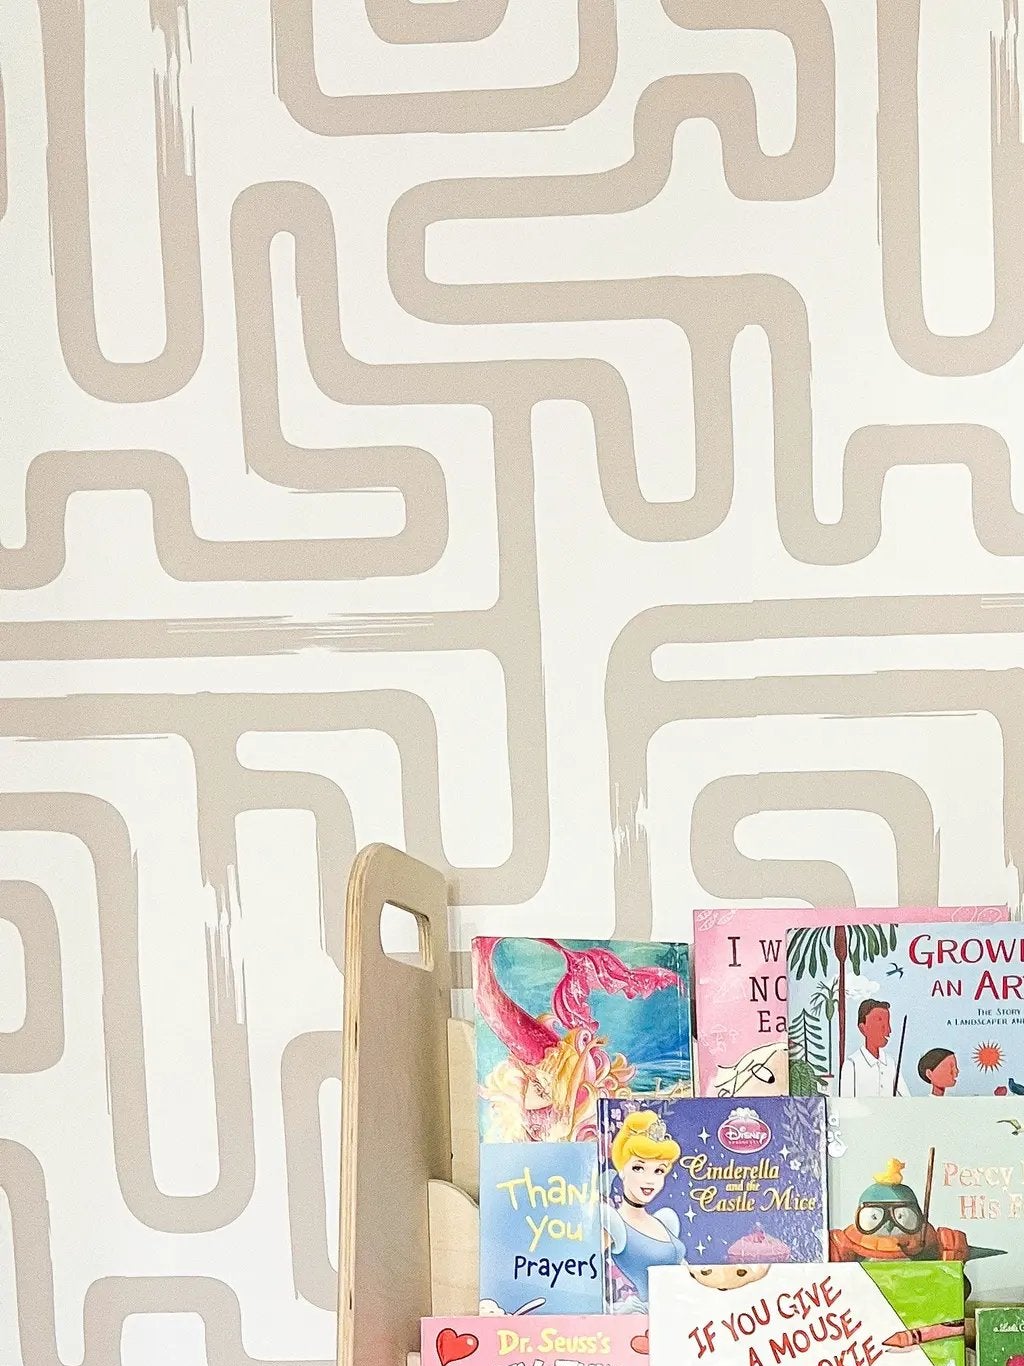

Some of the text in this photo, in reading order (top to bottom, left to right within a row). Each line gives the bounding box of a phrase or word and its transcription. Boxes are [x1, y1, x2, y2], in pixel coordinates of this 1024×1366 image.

[728, 937, 741, 967] I
[931, 980, 962, 997] AN
[680, 1153, 779, 1180] Cinderella
[942, 1161, 1011, 1187] Percy
[690, 1185, 817, 1212] Castle Mice
[725, 1179, 760, 1191] and the
[959, 1195, 1000, 1219] His
[688, 1276, 842, 1359] IF YOU GIVE
[496, 1327, 611, 1355] Dr. Seuss's
[769, 1308, 862, 1364] MOUSE
